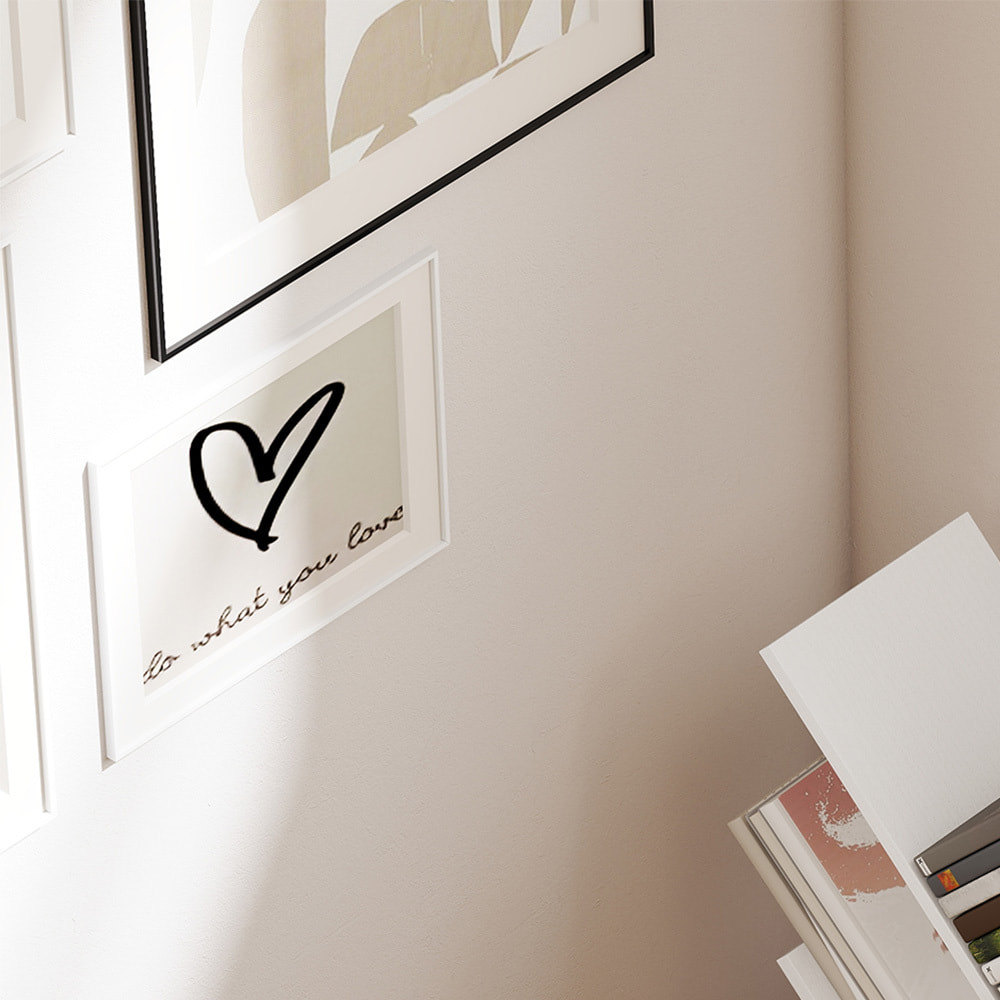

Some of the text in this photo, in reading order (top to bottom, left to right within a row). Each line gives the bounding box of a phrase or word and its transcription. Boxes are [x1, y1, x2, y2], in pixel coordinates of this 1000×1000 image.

[190, 586, 269, 652] what
[278, 552, 339, 605] you
[347, 505, 403, 550] love
